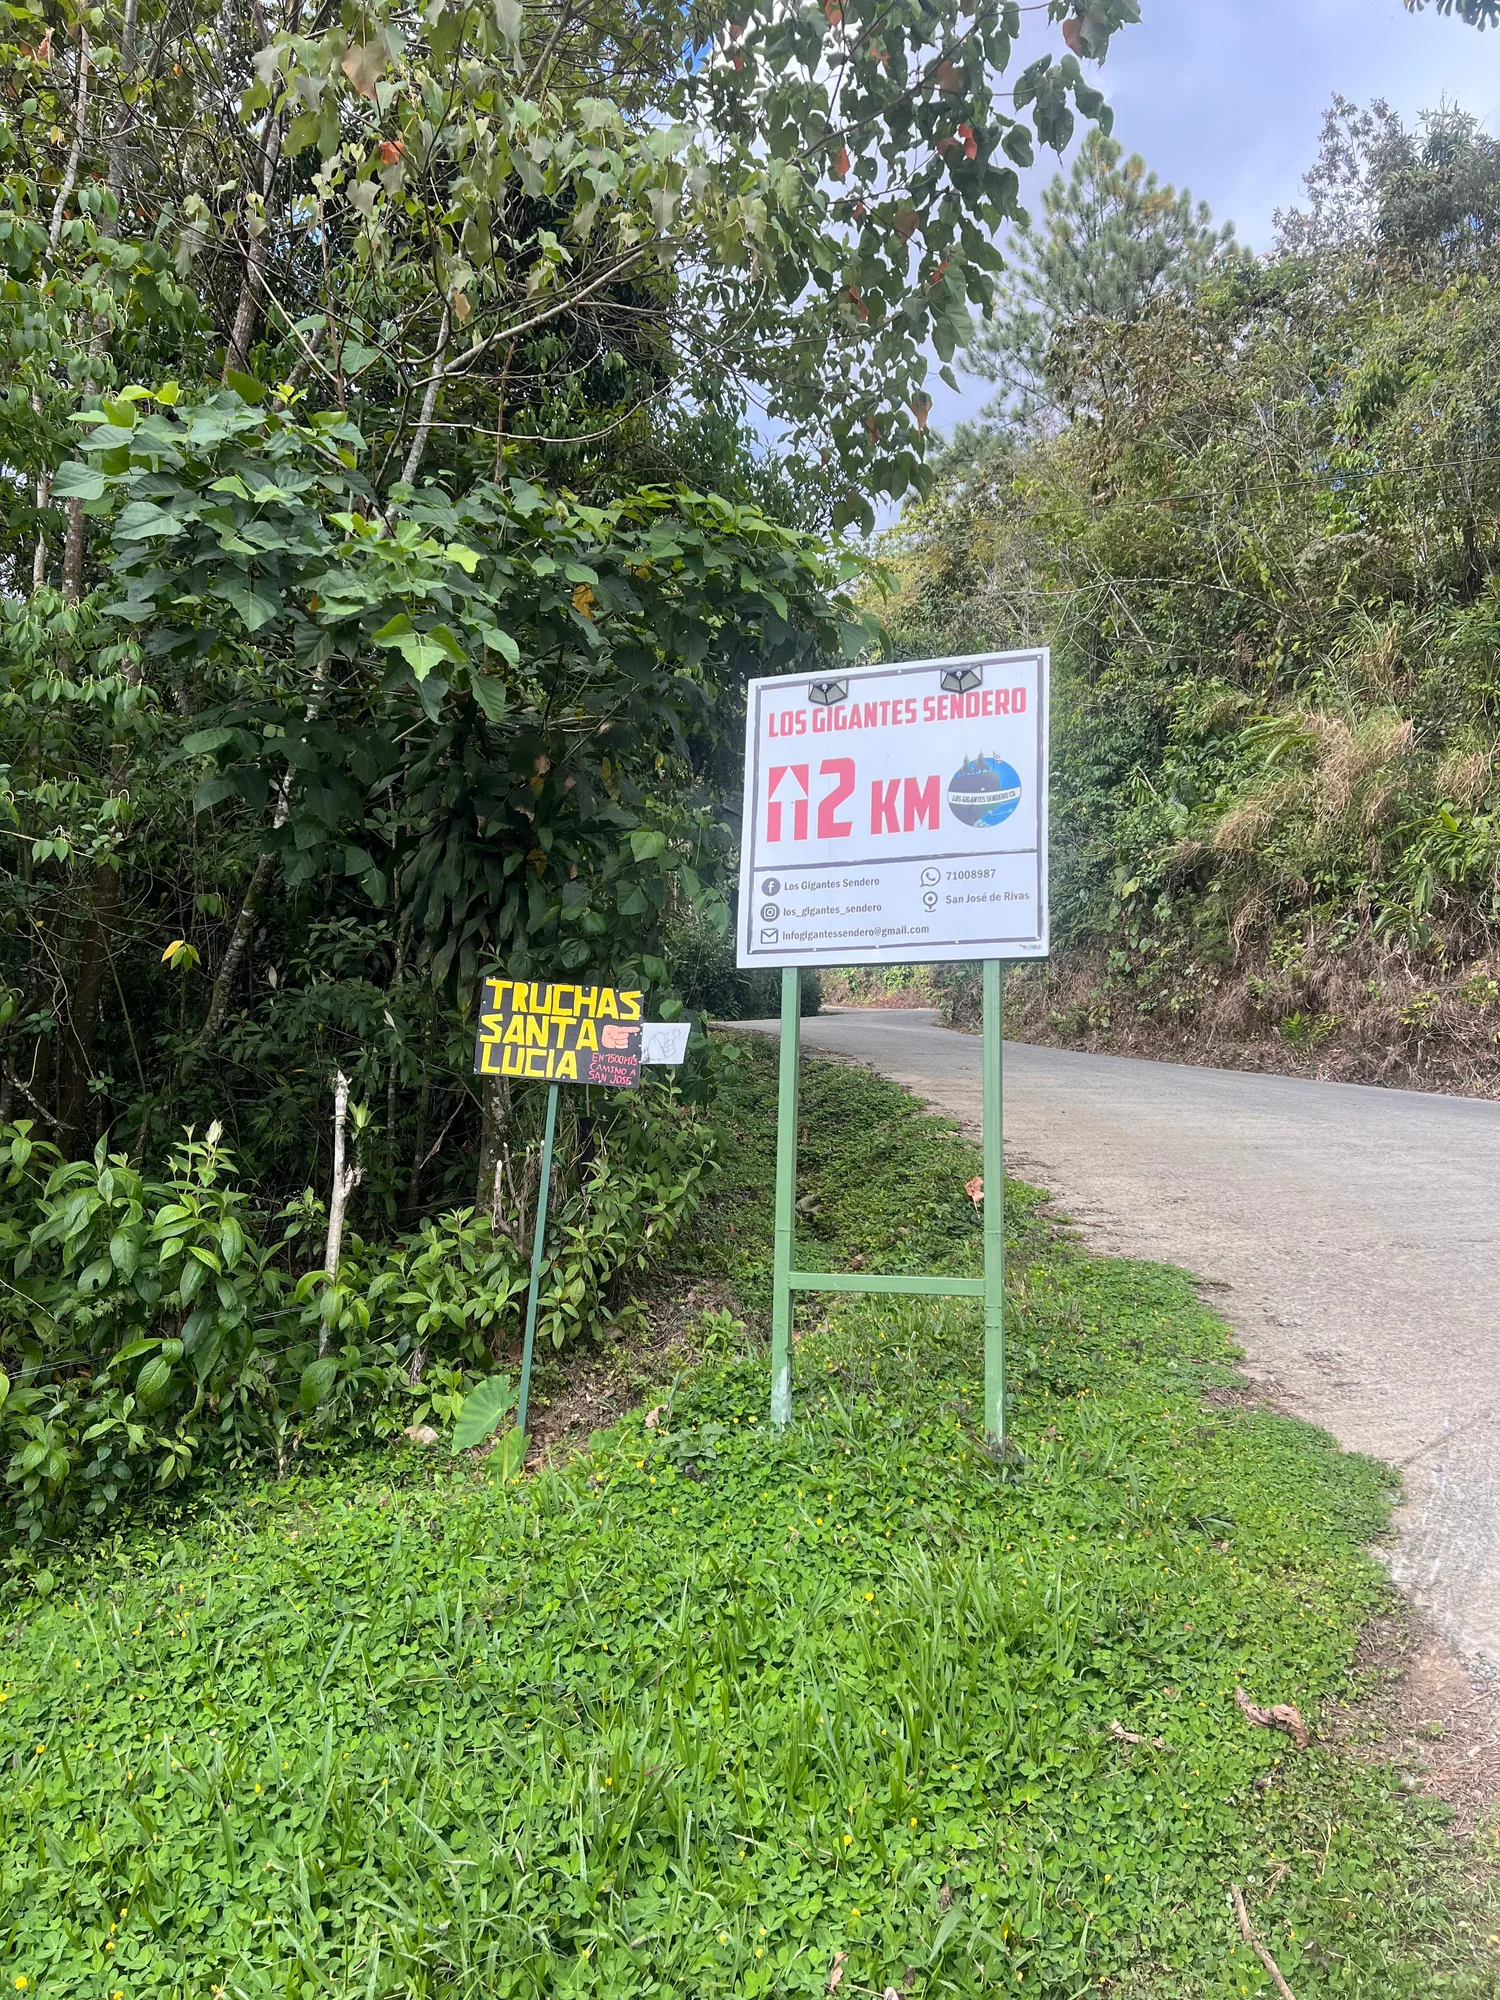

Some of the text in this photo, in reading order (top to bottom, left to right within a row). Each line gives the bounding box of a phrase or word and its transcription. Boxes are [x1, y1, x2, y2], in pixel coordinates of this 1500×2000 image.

[769, 687, 1027, 738] LOS GIGANTES SENDERO
[817, 757, 941, 839] 2 KM
[986, 793, 1008, 802] SENDERO
[946, 869, 997, 881] 71008987
[784, 878, 880, 891] Los Gigantes Sendero
[945, 891, 1030, 904] San José de Rivas
[783, 904, 882, 918] los_gigantes_sendero
[485, 979, 642, 1020] TRUCHAS
[479, 1014, 599, 1051] SANTA
[480, 1043, 578, 1080] LUCIA
[592, 1052, 604, 1063] EN
[590, 1062, 636, 1076] CAMINO A
[588, 1070, 632, 1085] SAN JOSE
